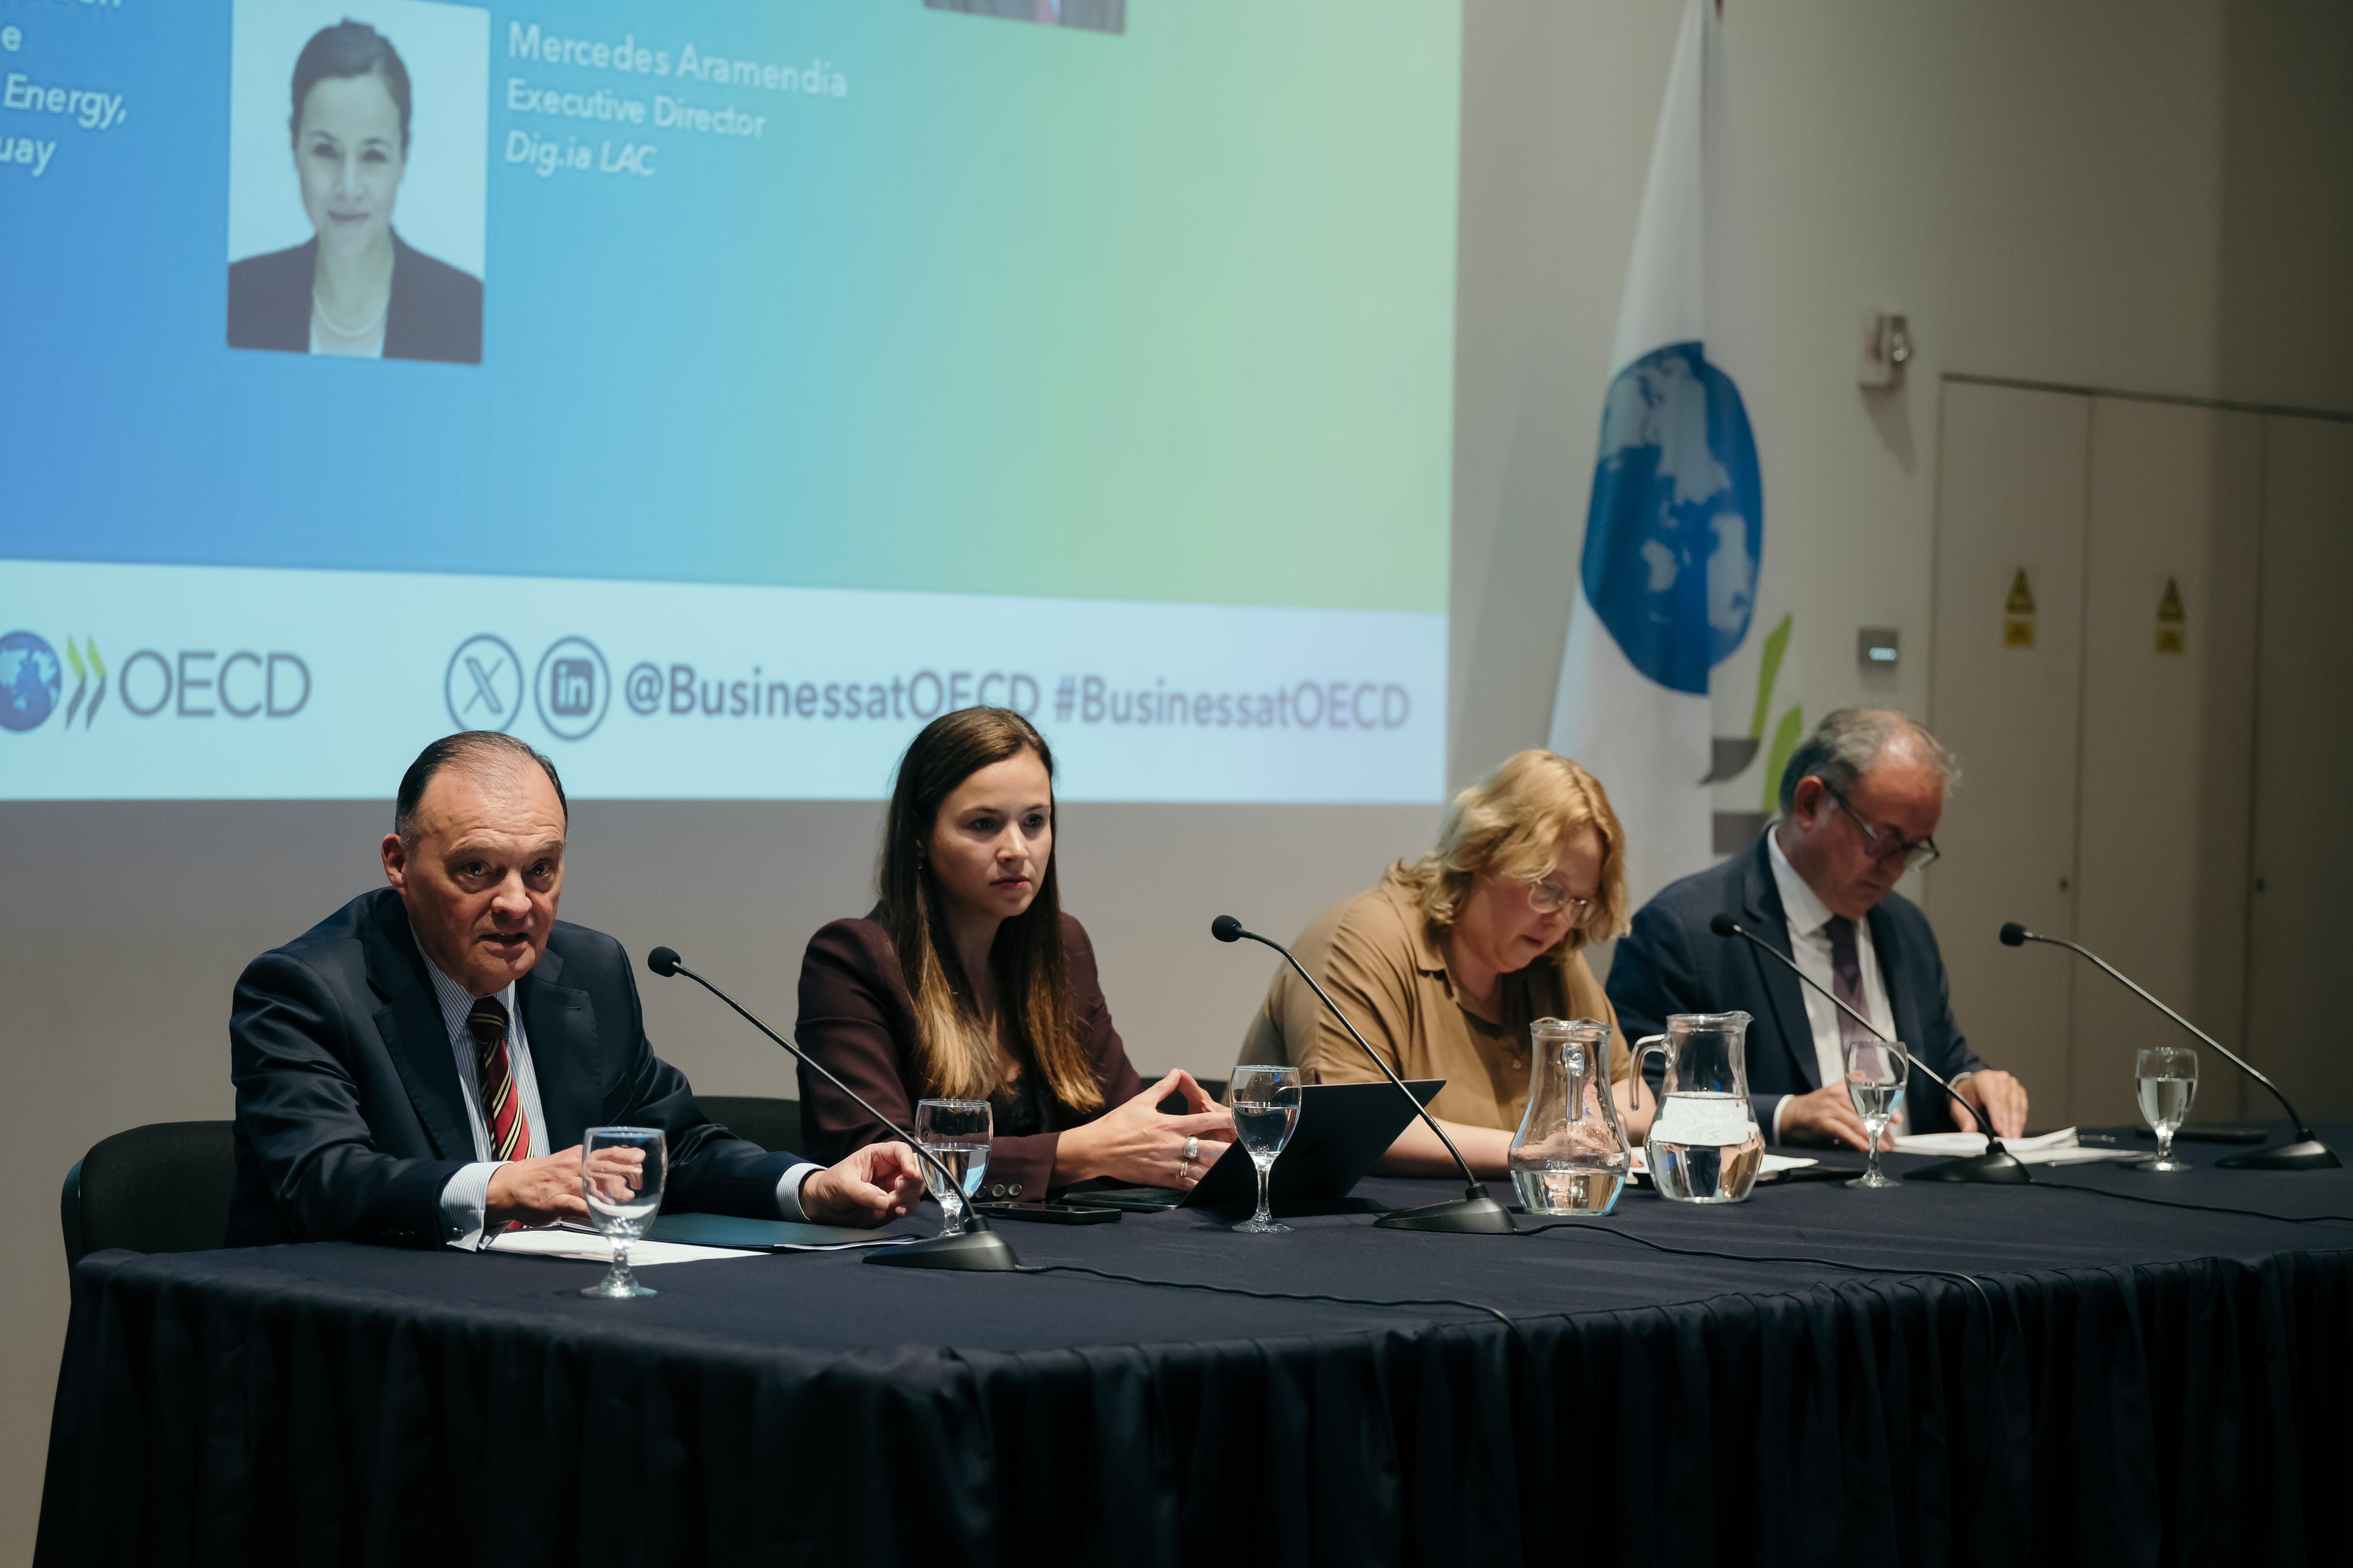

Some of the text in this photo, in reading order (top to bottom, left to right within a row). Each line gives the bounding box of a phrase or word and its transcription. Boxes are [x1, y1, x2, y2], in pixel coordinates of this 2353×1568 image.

[509, 20, 848, 97] Mercedes Aramendía
[4, 73, 127, 129] Energy,
[507, 77, 766, 138] Executive Director
[505, 130, 657, 177] Dig.ia LAC
[119, 648, 312, 720] OECD
[1055, 675, 1410, 729] #BusinessatOECD
